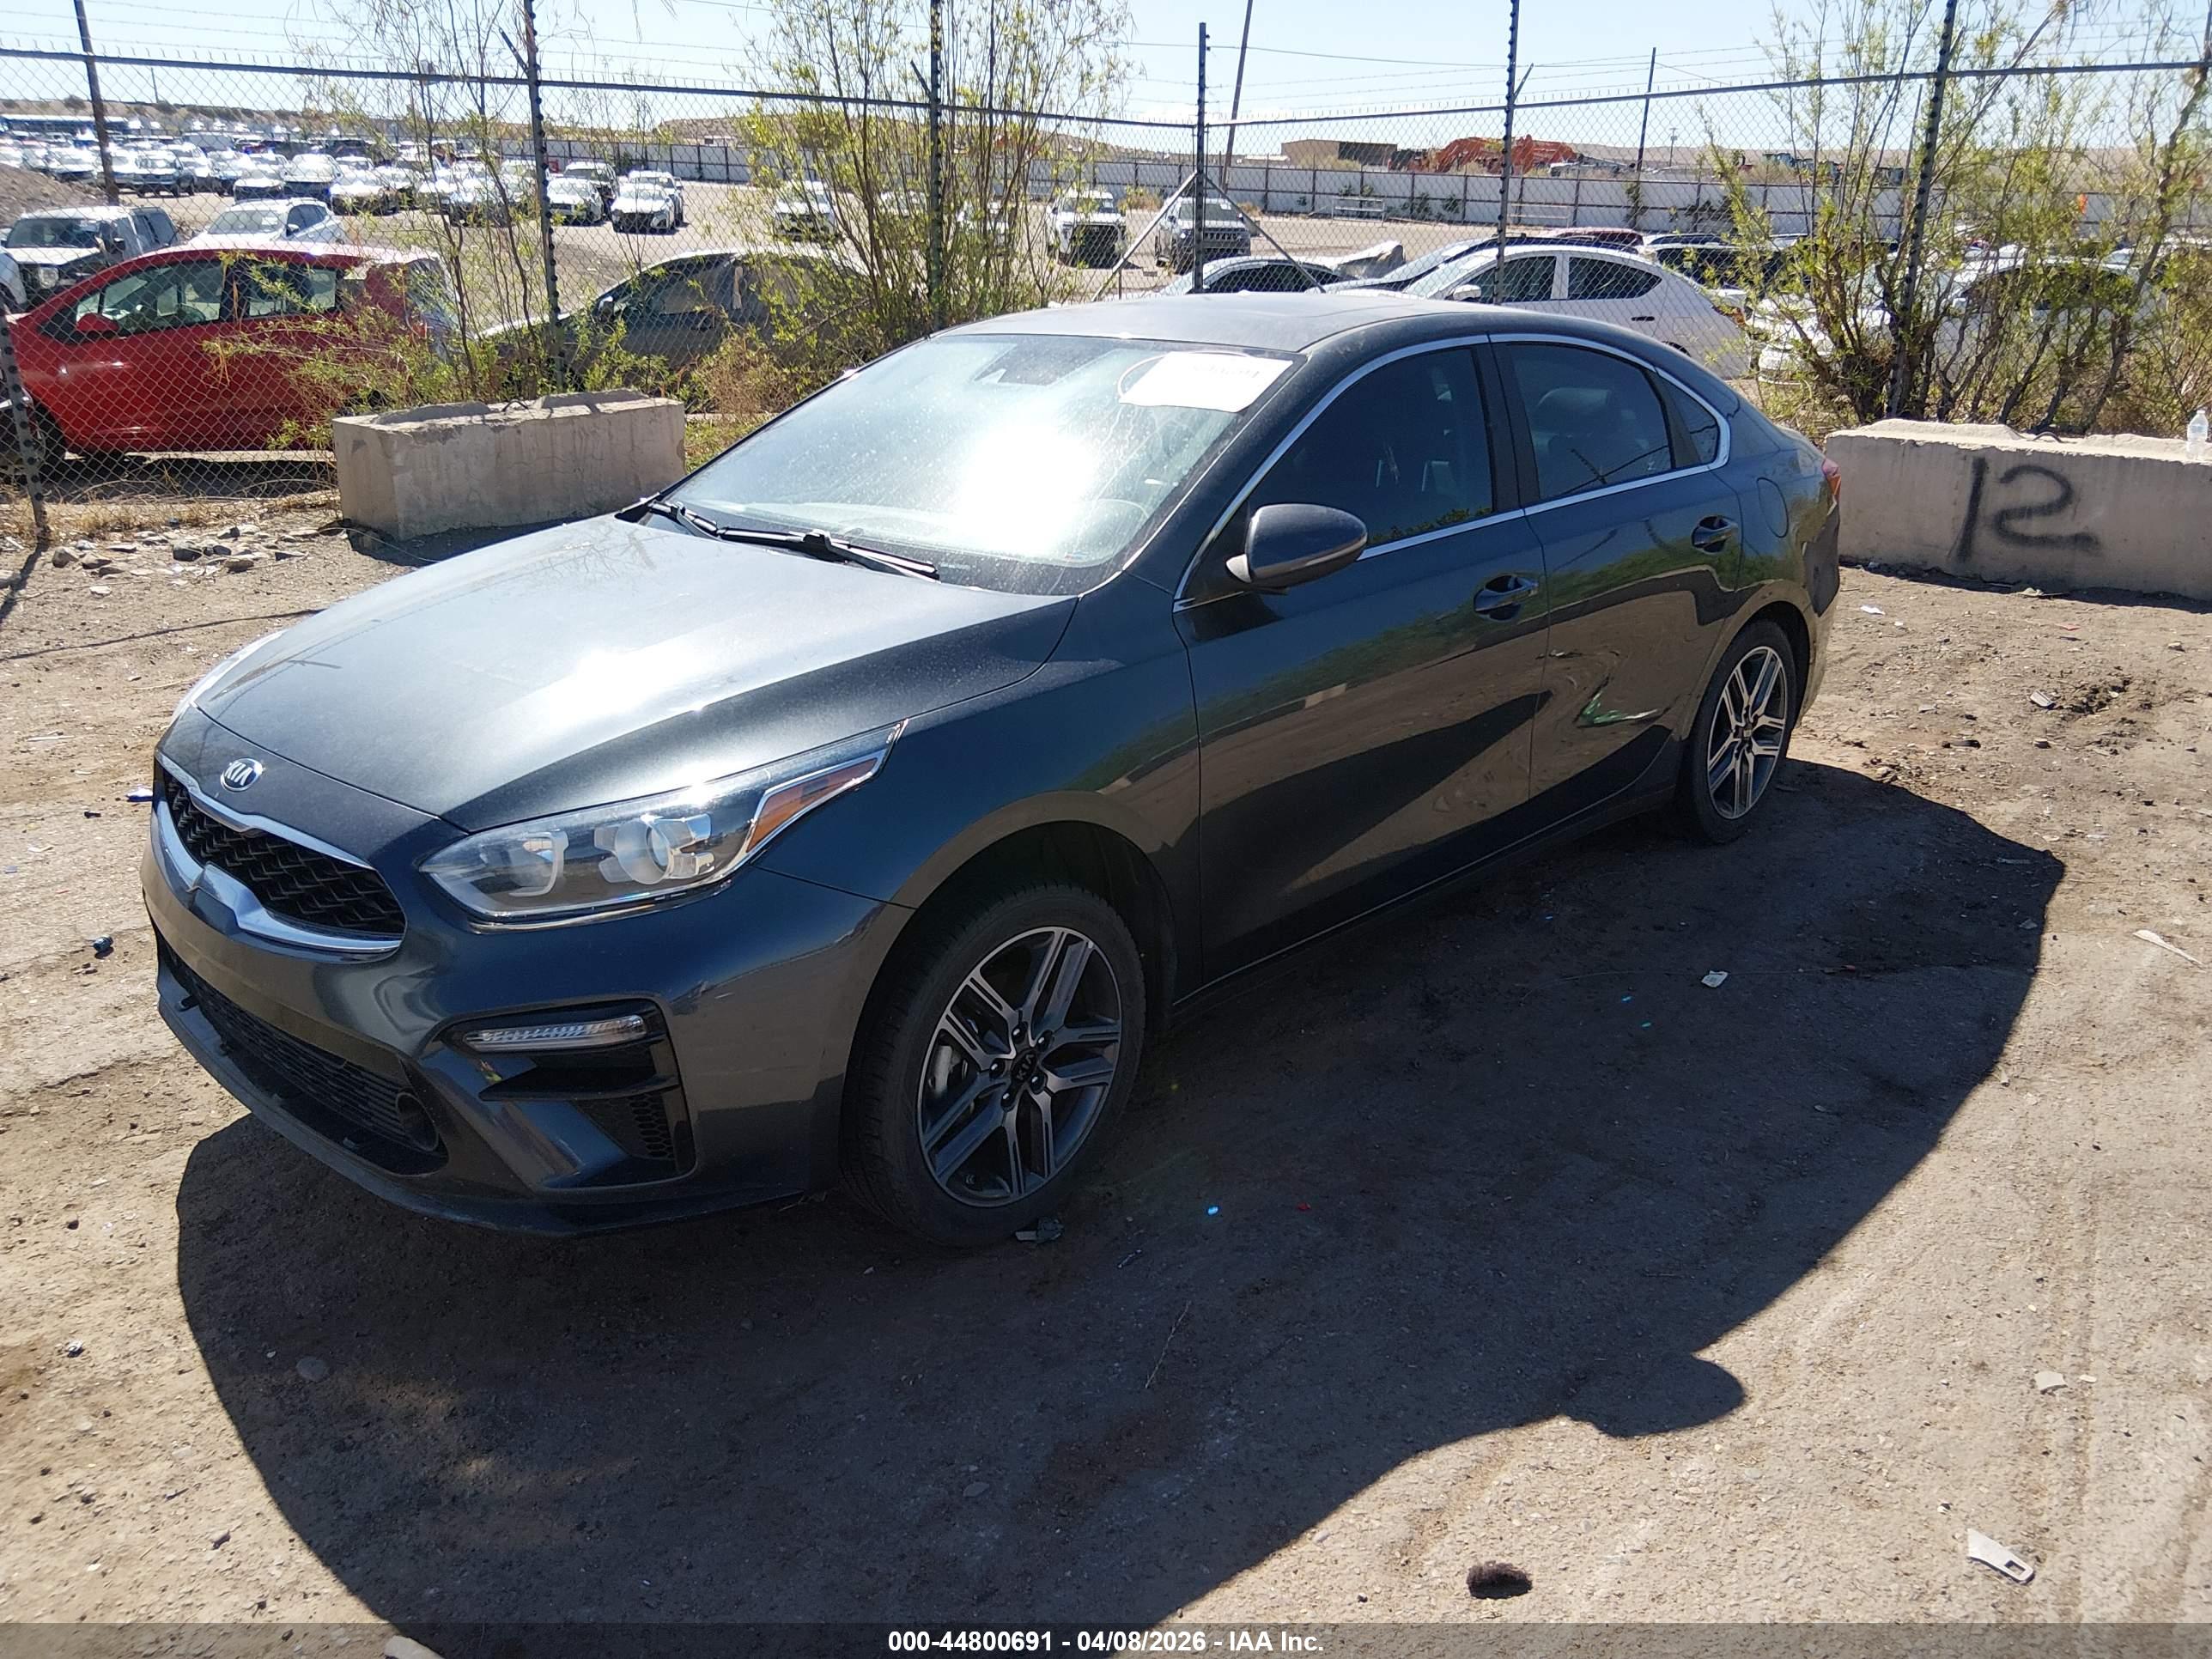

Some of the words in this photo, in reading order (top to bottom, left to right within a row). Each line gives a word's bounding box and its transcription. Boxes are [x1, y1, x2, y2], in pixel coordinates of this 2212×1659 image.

[1955, 456, 2100, 563] 12
[224, 761, 253, 787] KIA
[1016, 1054, 1035, 1081] KIA
